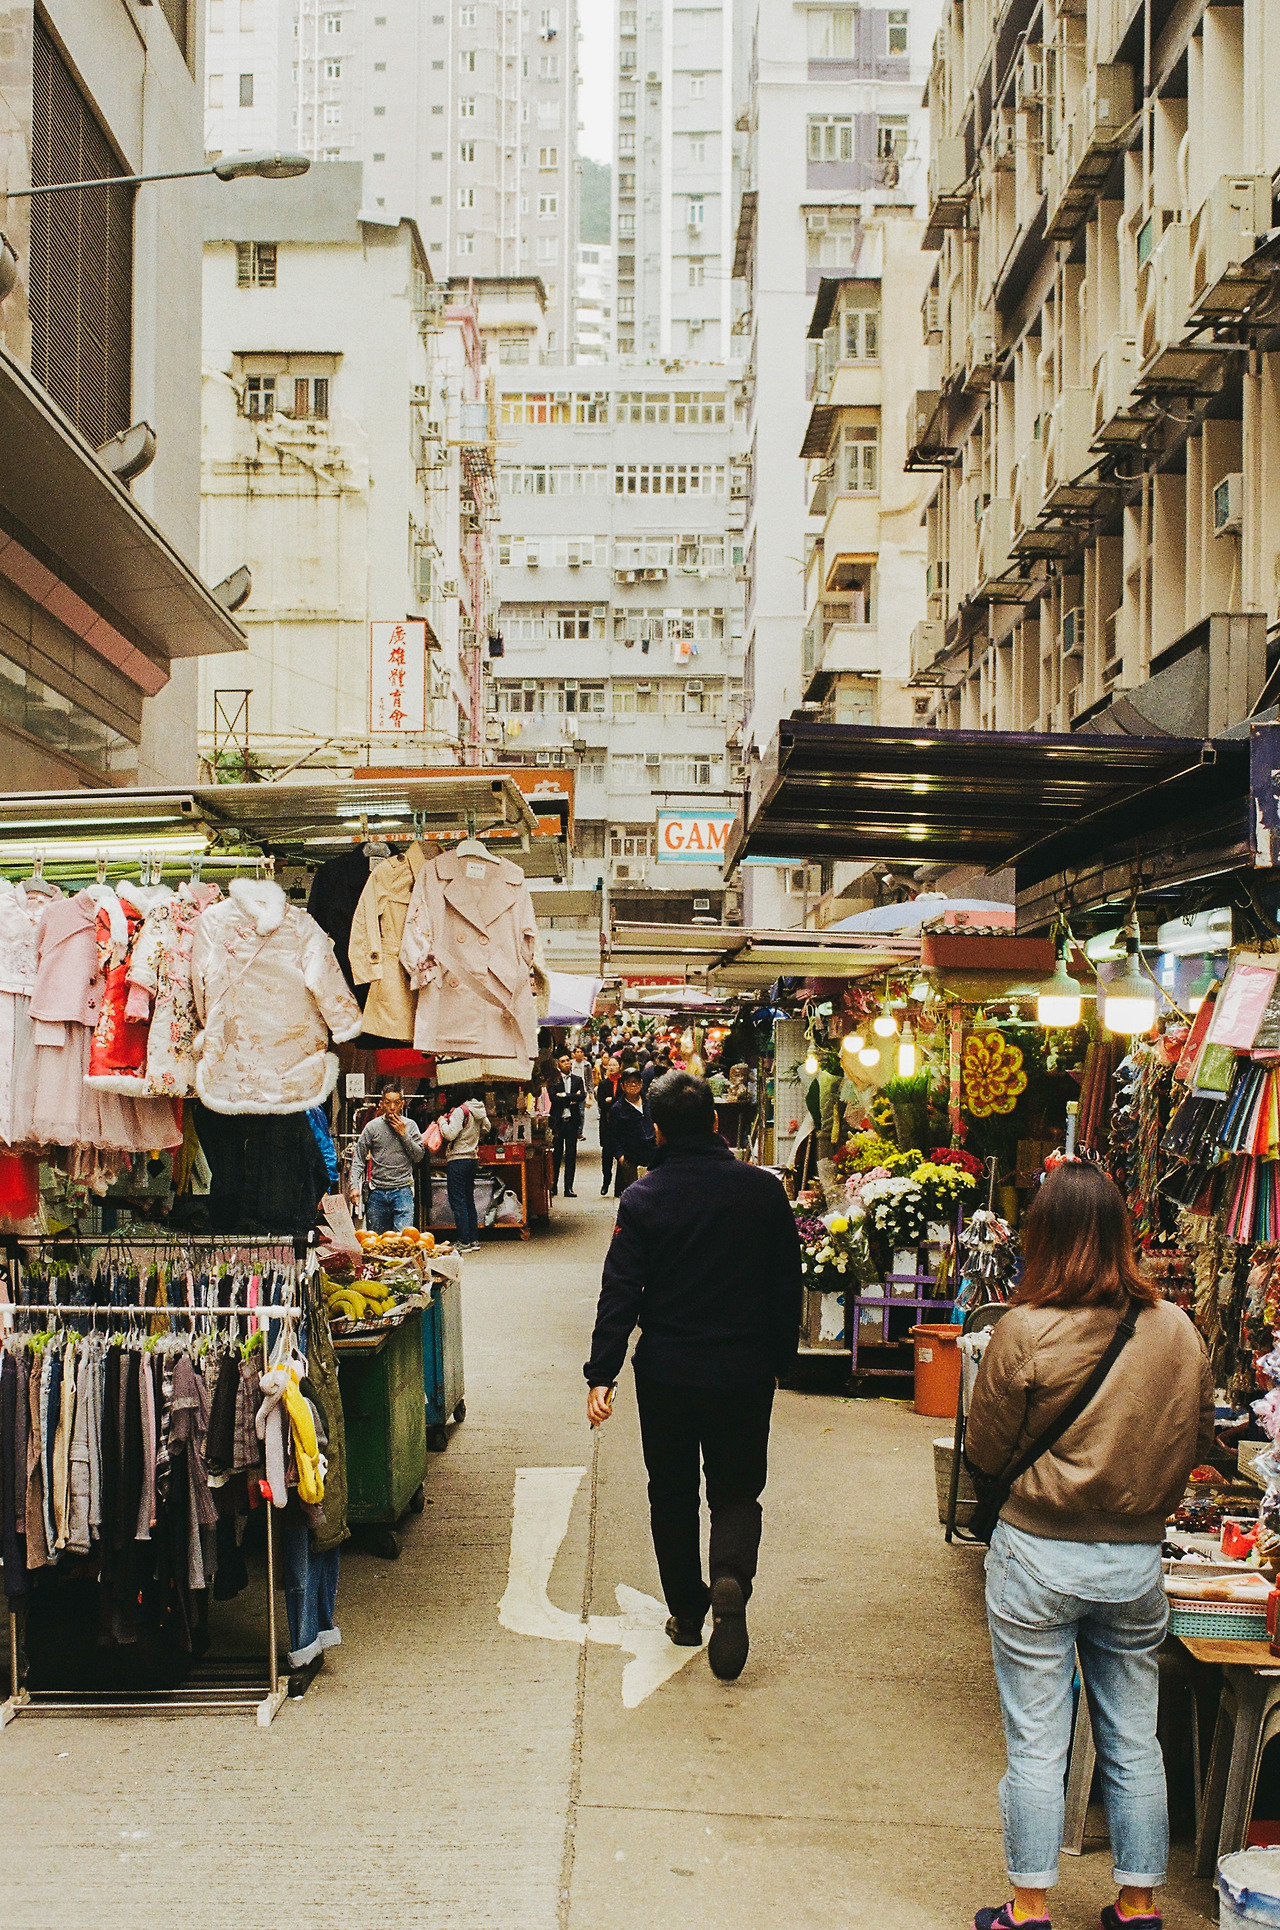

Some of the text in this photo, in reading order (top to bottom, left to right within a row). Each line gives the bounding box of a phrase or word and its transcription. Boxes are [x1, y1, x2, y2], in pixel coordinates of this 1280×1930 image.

[388, 625, 408, 728] 廣雄體育會
